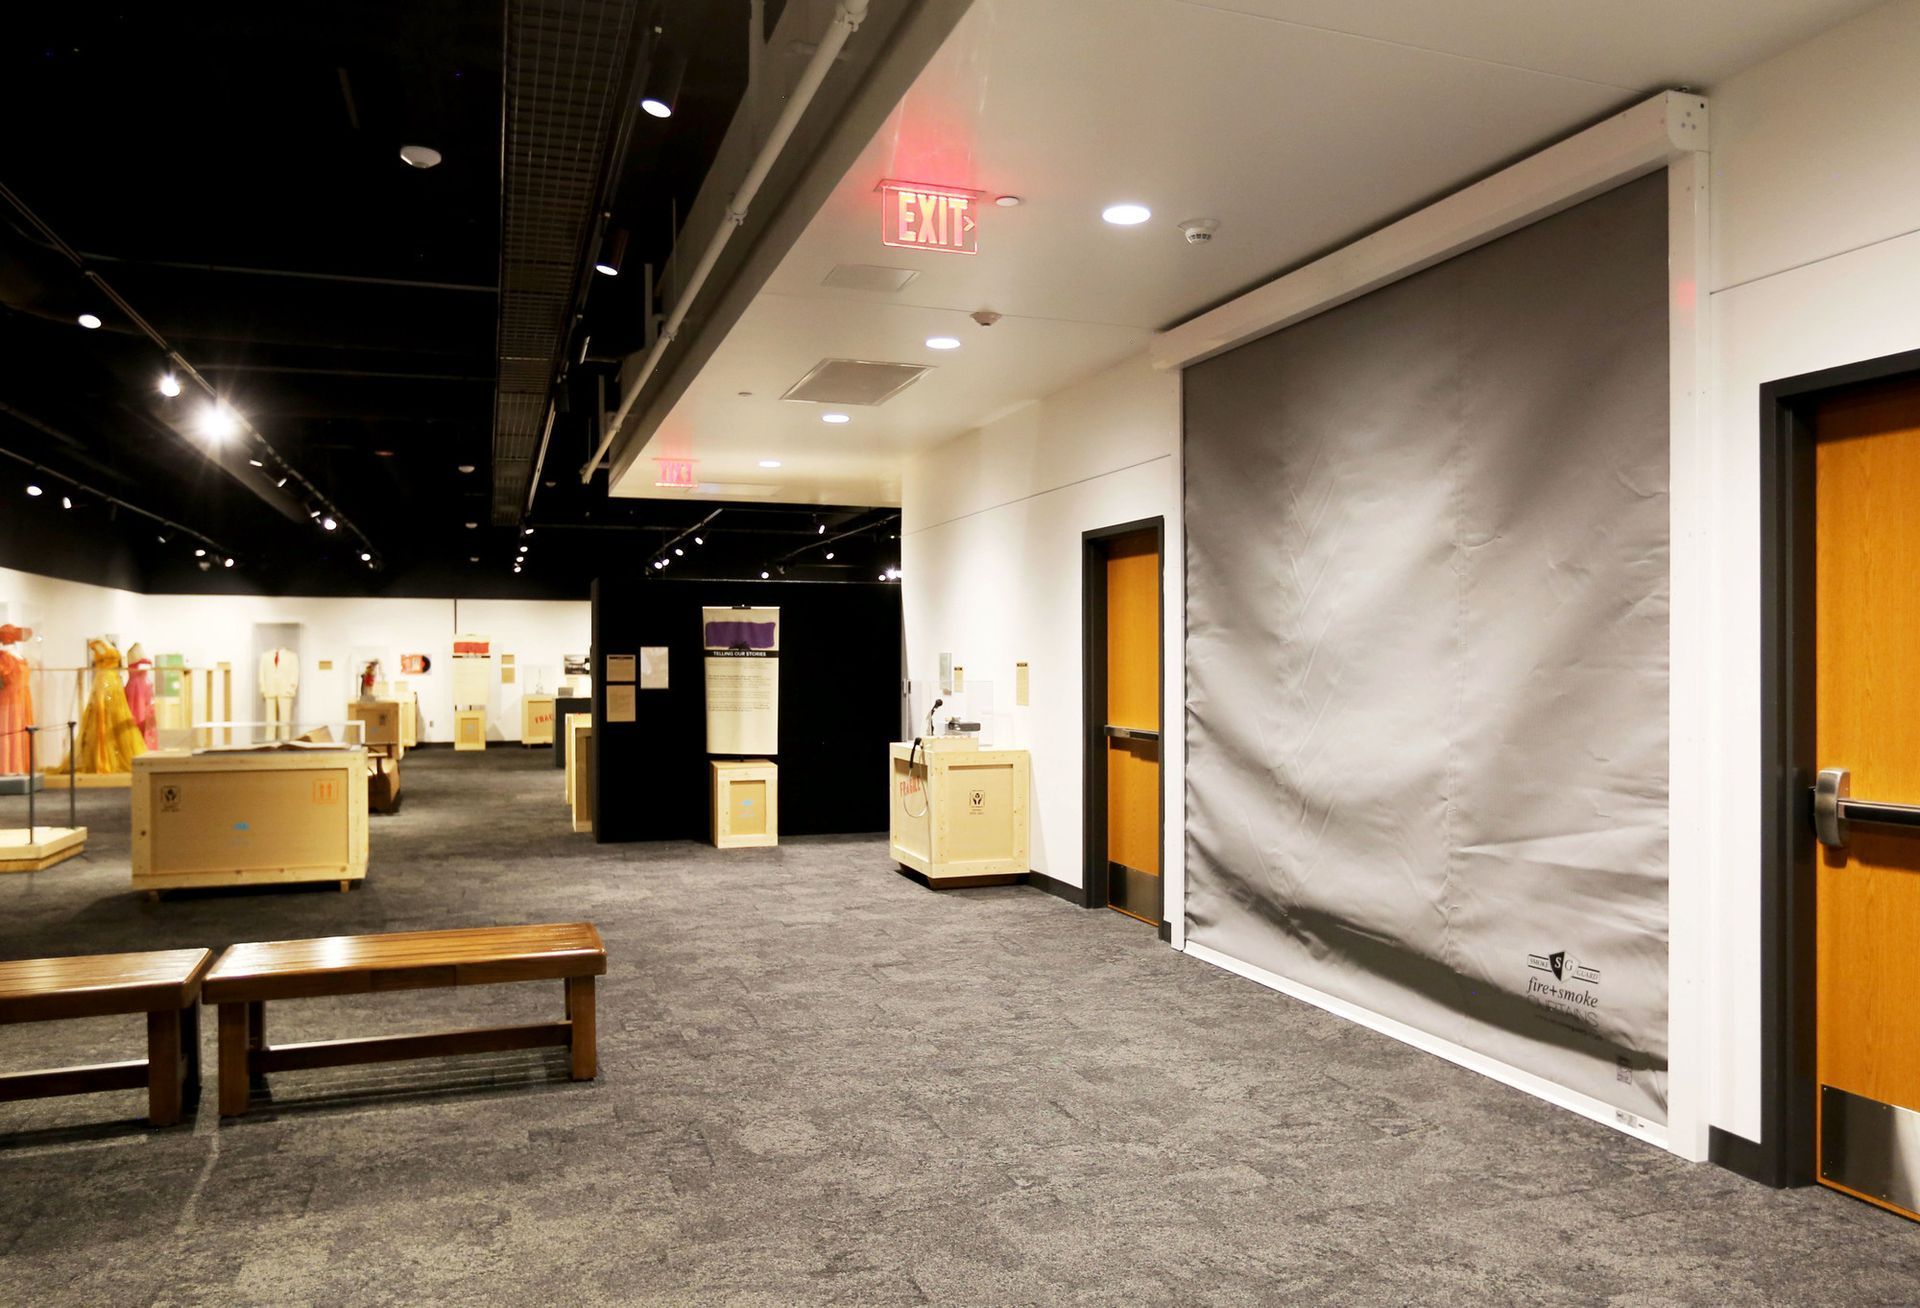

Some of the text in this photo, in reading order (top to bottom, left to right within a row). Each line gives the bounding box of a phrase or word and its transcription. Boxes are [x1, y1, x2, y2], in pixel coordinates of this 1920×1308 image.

[898, 191, 968, 247] EXIT
[1576, 969, 1599, 980] GUARD
[1526, 976, 1599, 1008] fire+smoke
[1526, 994, 1599, 1028] CURTAINS
